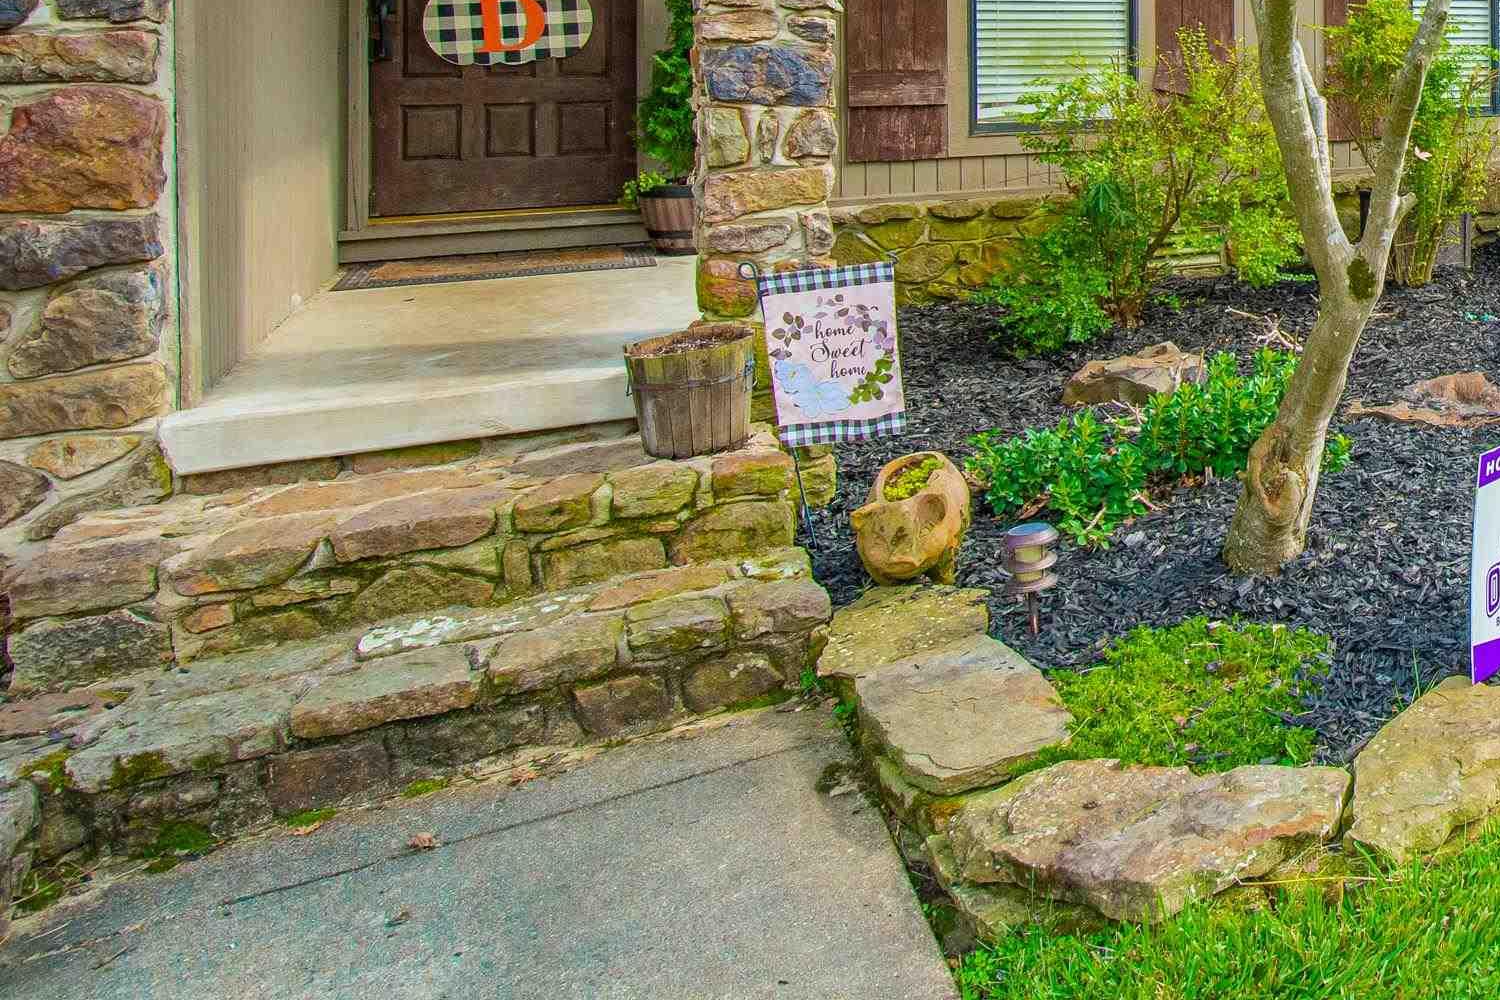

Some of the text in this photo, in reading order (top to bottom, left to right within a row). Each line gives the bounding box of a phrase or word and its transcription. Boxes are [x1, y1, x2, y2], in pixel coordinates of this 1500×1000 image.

[815, 320, 855, 339] home
[810, 338, 872, 363] Sweet
[831, 360, 867, 378] home
